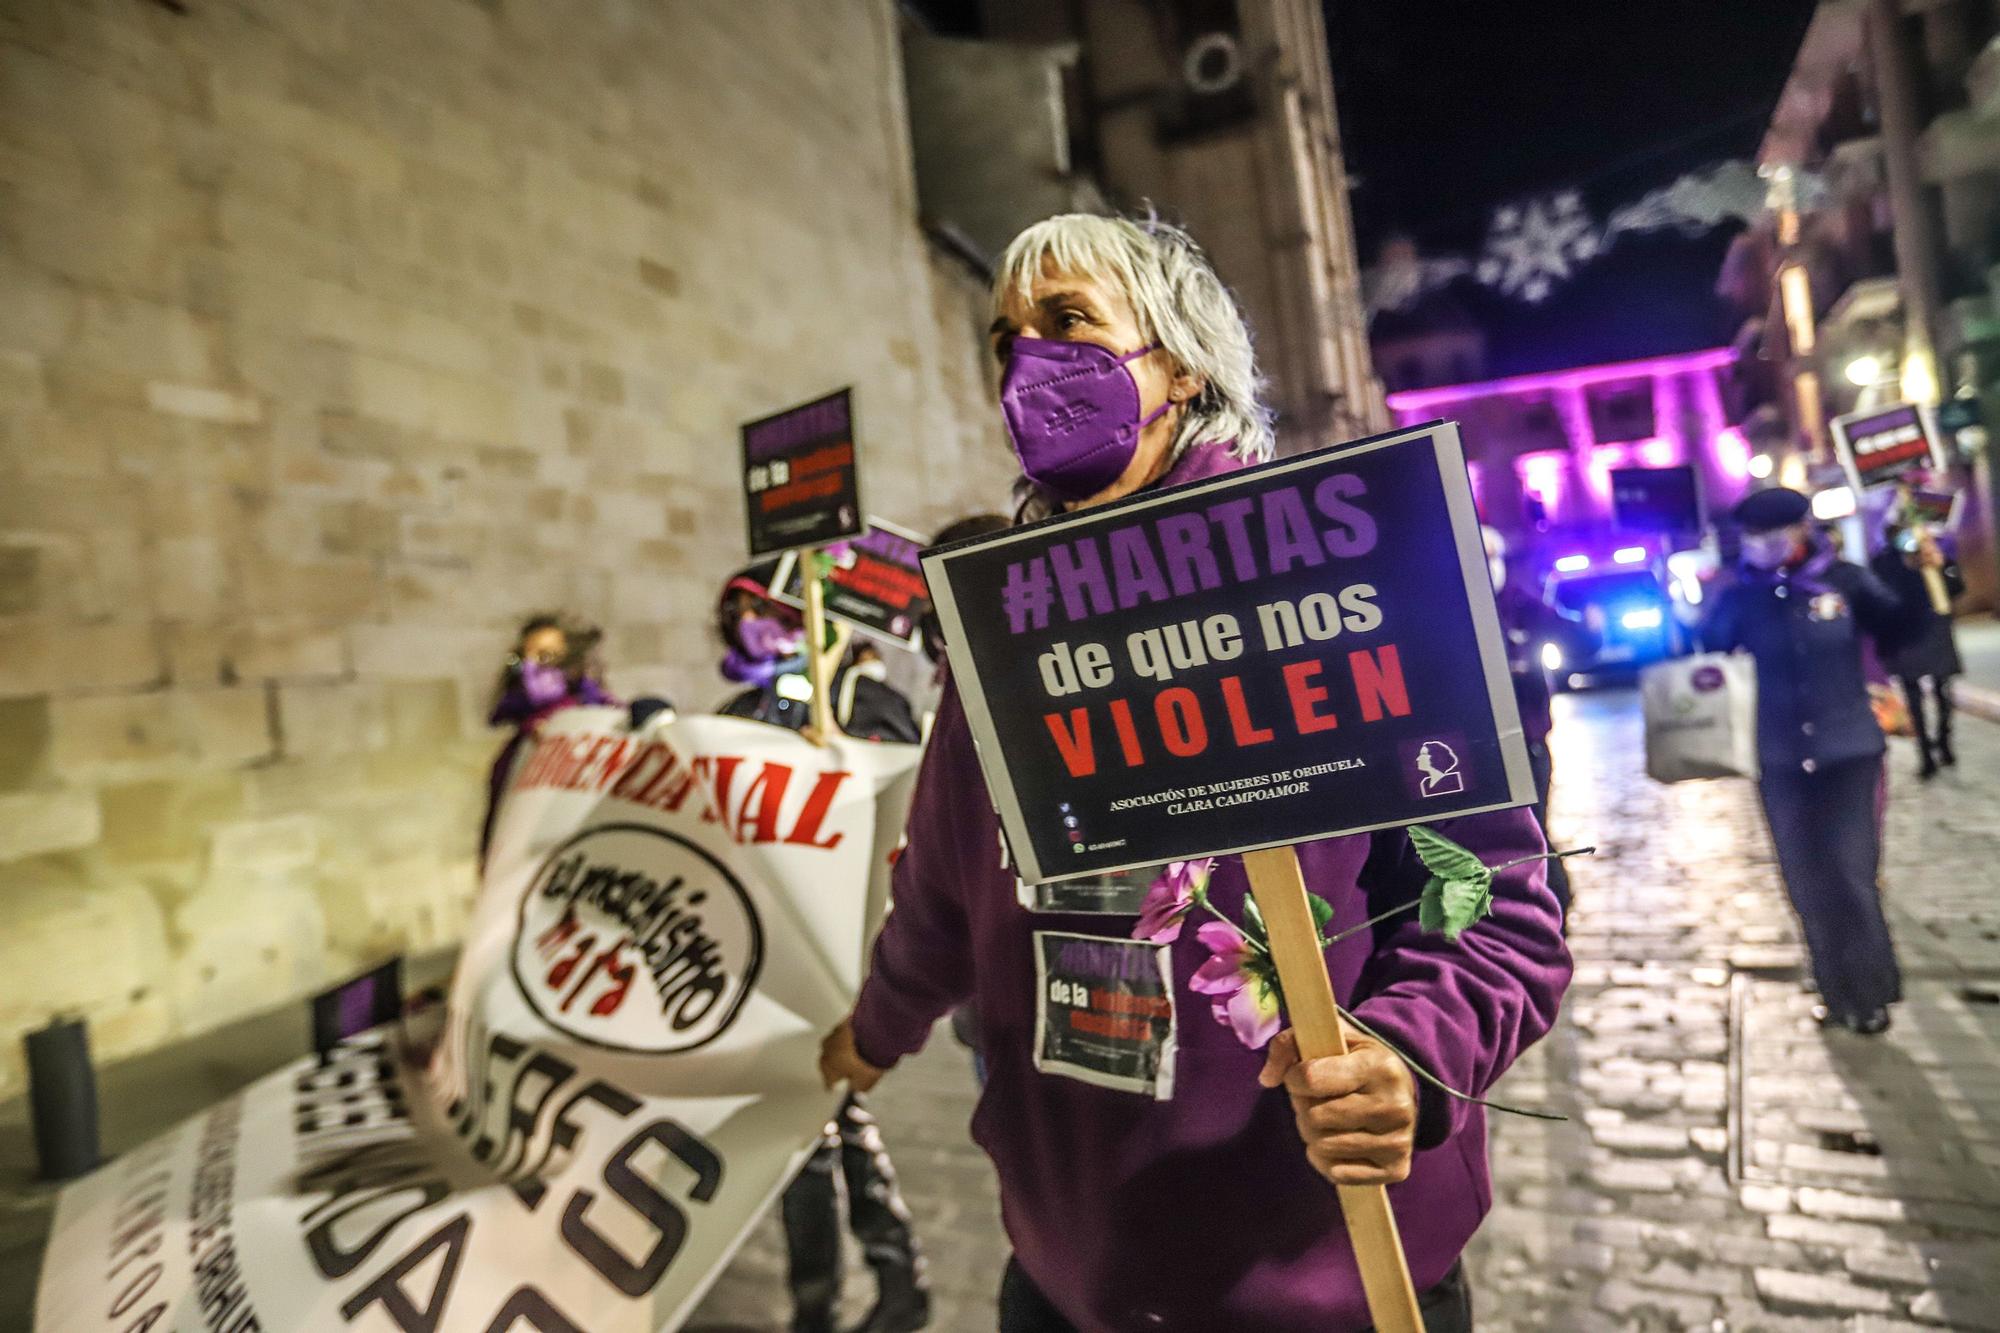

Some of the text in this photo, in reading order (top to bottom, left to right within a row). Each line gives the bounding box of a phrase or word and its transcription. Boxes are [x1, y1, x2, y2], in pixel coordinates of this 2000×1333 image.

[1001, 473, 1379, 634] #HARTAS
[1037, 583, 1384, 697] de que nos
[1043, 643, 1413, 779] VIOLEN
[1109, 757, 1367, 812] ASOCIACIÓN DE MUJERES DE ORIHUELA
[1166, 781, 1310, 815] CLARA CAMPOAMOR
[1050, 979, 1071, 1005] de
[1072, 981, 1089, 1008] la
